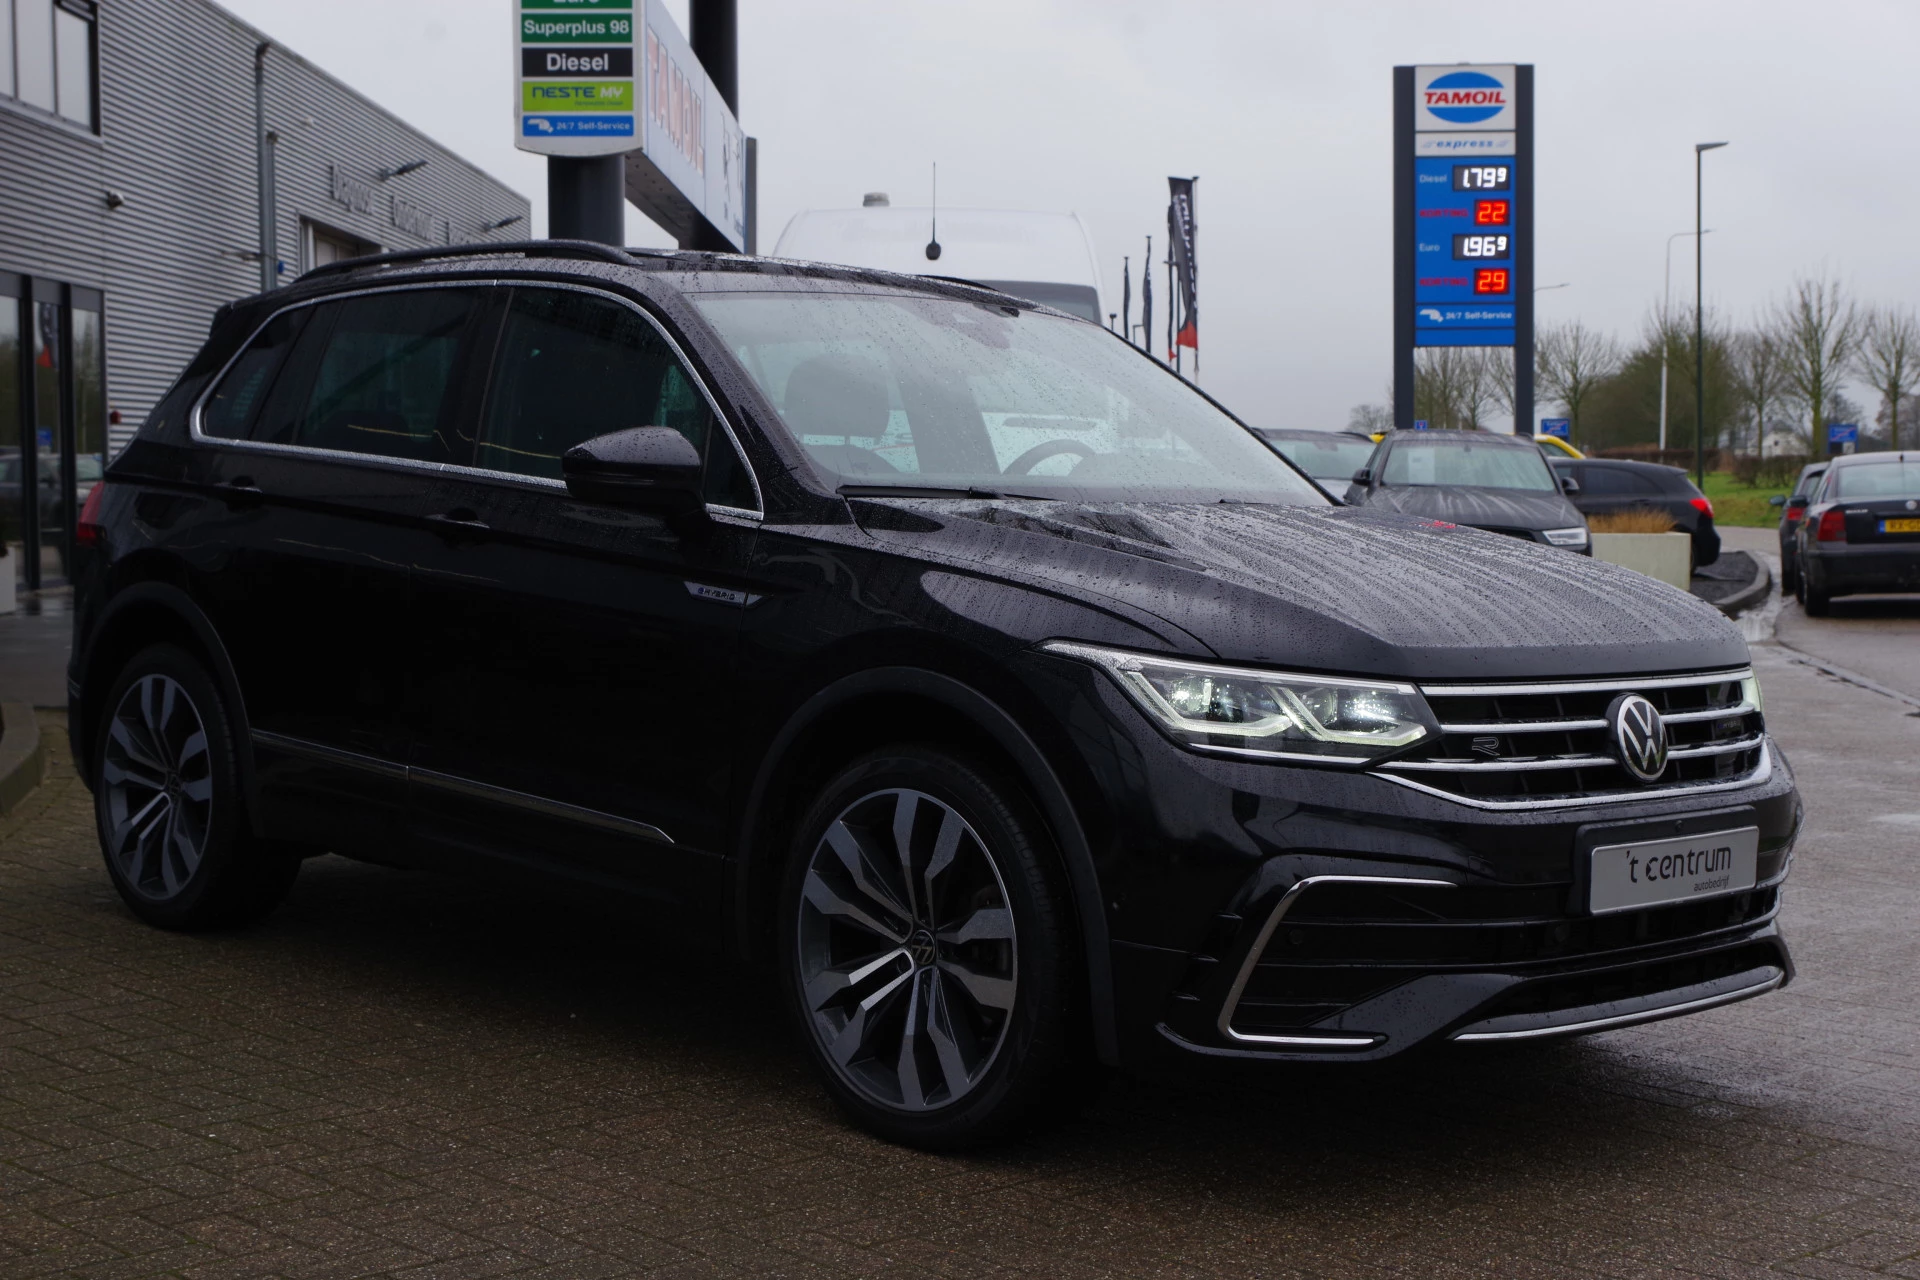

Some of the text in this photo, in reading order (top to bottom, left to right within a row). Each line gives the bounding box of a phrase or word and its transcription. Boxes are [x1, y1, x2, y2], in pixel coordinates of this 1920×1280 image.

[524, 19, 630, 37] Superplus 98
[546, 53, 609, 71] Diesel
[532, 86, 624, 98] NESTE MY
[1424, 91, 1506, 105] TAMOIL
[556, 121, 631, 131] 24/7 Self-Service
[1436, 140, 1494, 149] express
[1419, 174, 1447, 183] Diesel
[1477, 201, 1508, 223] 22
[1419, 243, 1440, 252] Euro
[1477, 270, 1507, 292] 29
[1465, 311, 1512, 320] Self-Service
[1471, 736, 1500, 756] R
[1646, 846, 1732, 882] centrum
[1693, 875, 1730, 892] autobedrijf
